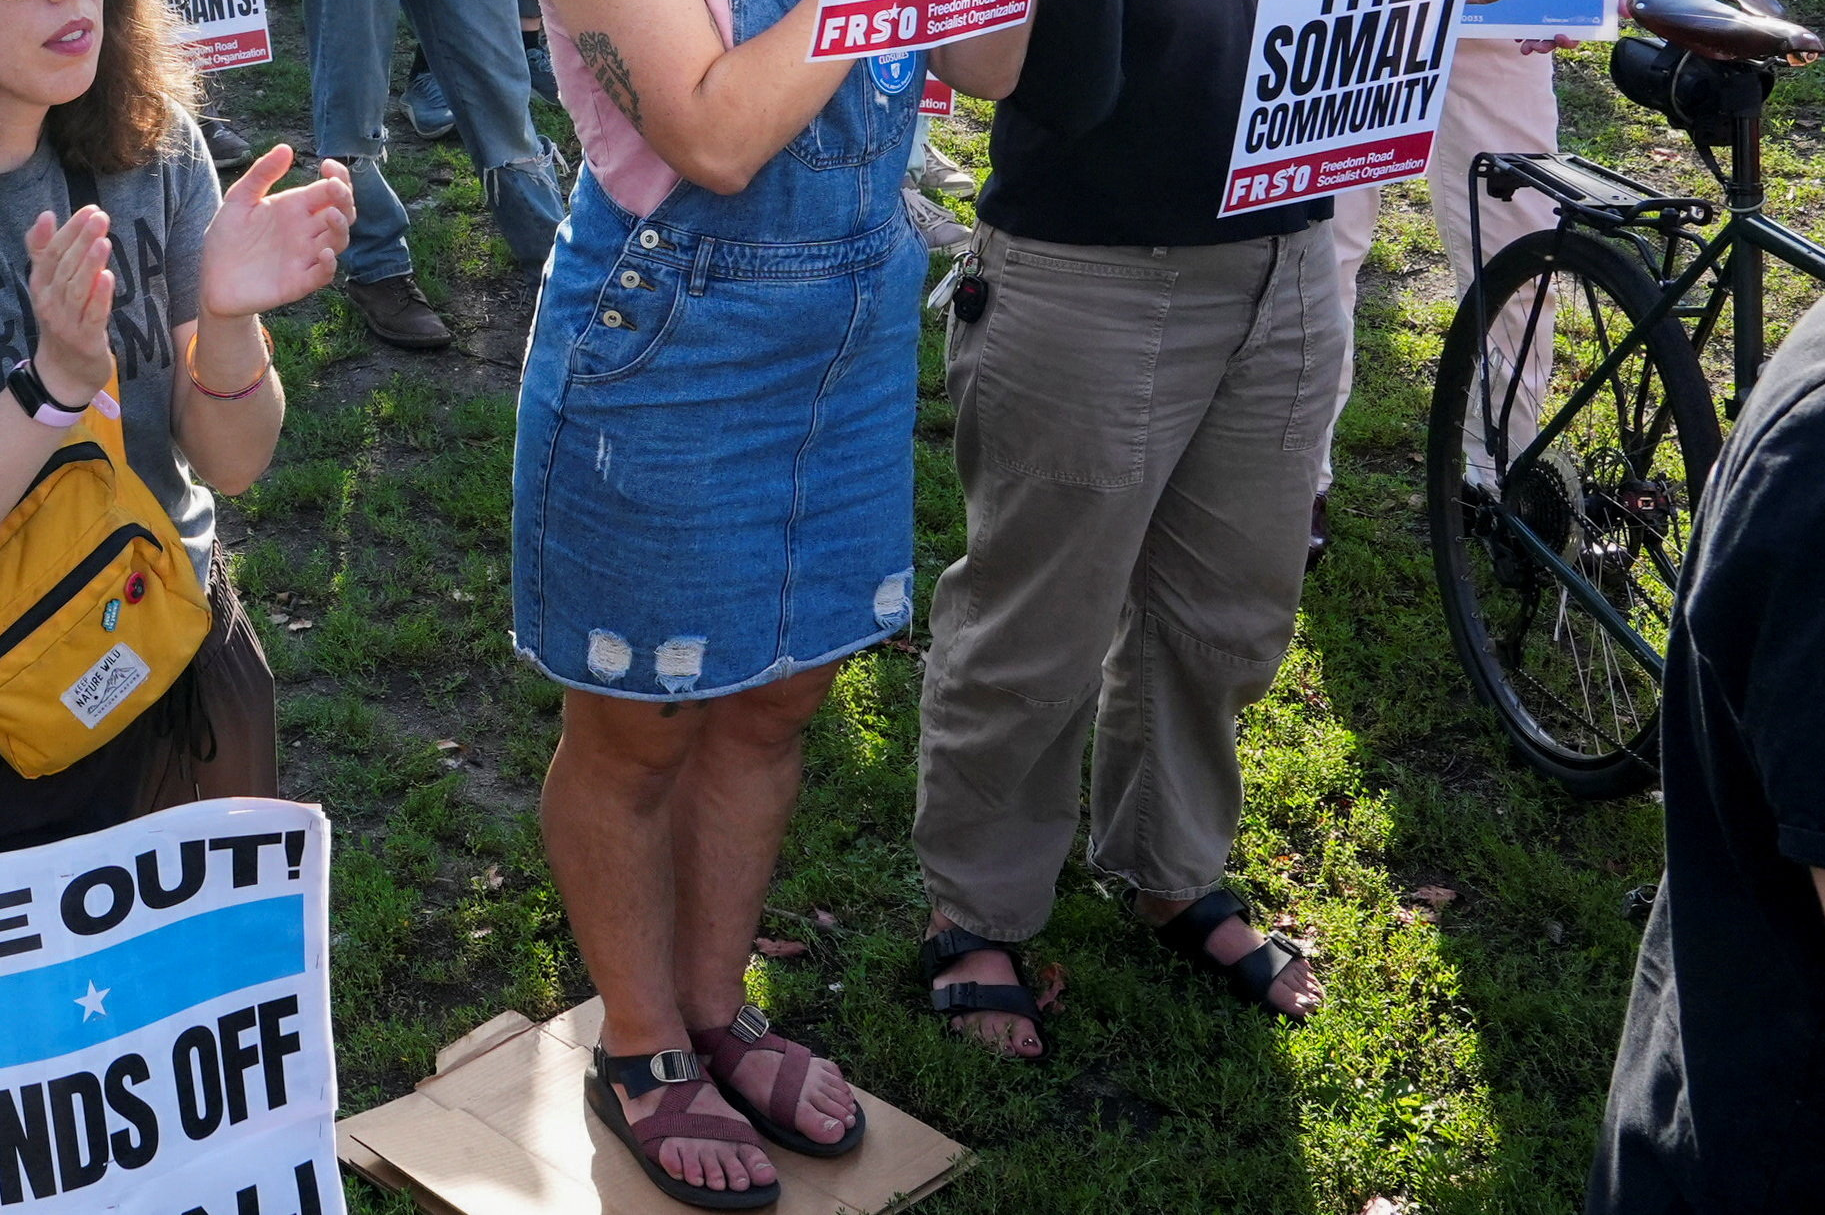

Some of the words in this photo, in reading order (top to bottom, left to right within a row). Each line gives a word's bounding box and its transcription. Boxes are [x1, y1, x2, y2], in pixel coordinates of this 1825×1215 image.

[926, 14, 968, 36] Socialist
[967, 1, 1026, 25] Organization
[212, 47, 267, 66] Organization
[214, 39, 239, 53] Road
[1244, 73, 1440, 155] COMMUNITY
[1316, 168, 1361, 188] Socialist
[1360, 158, 1425, 179] Organization
[1319, 157, 1366, 174] Freedom
[1366, 149, 1395, 165] Road
[74, 676, 90, 696] KEEP
[75, 672, 104, 708] NATURE
[100, 649, 121, 672] WILD
[93, 695, 119, 718] NURTURE
[119, 672, 141, 694] NATURE
[59, 829, 307, 937] OUT!
[172, 993, 302, 1142] OFF
